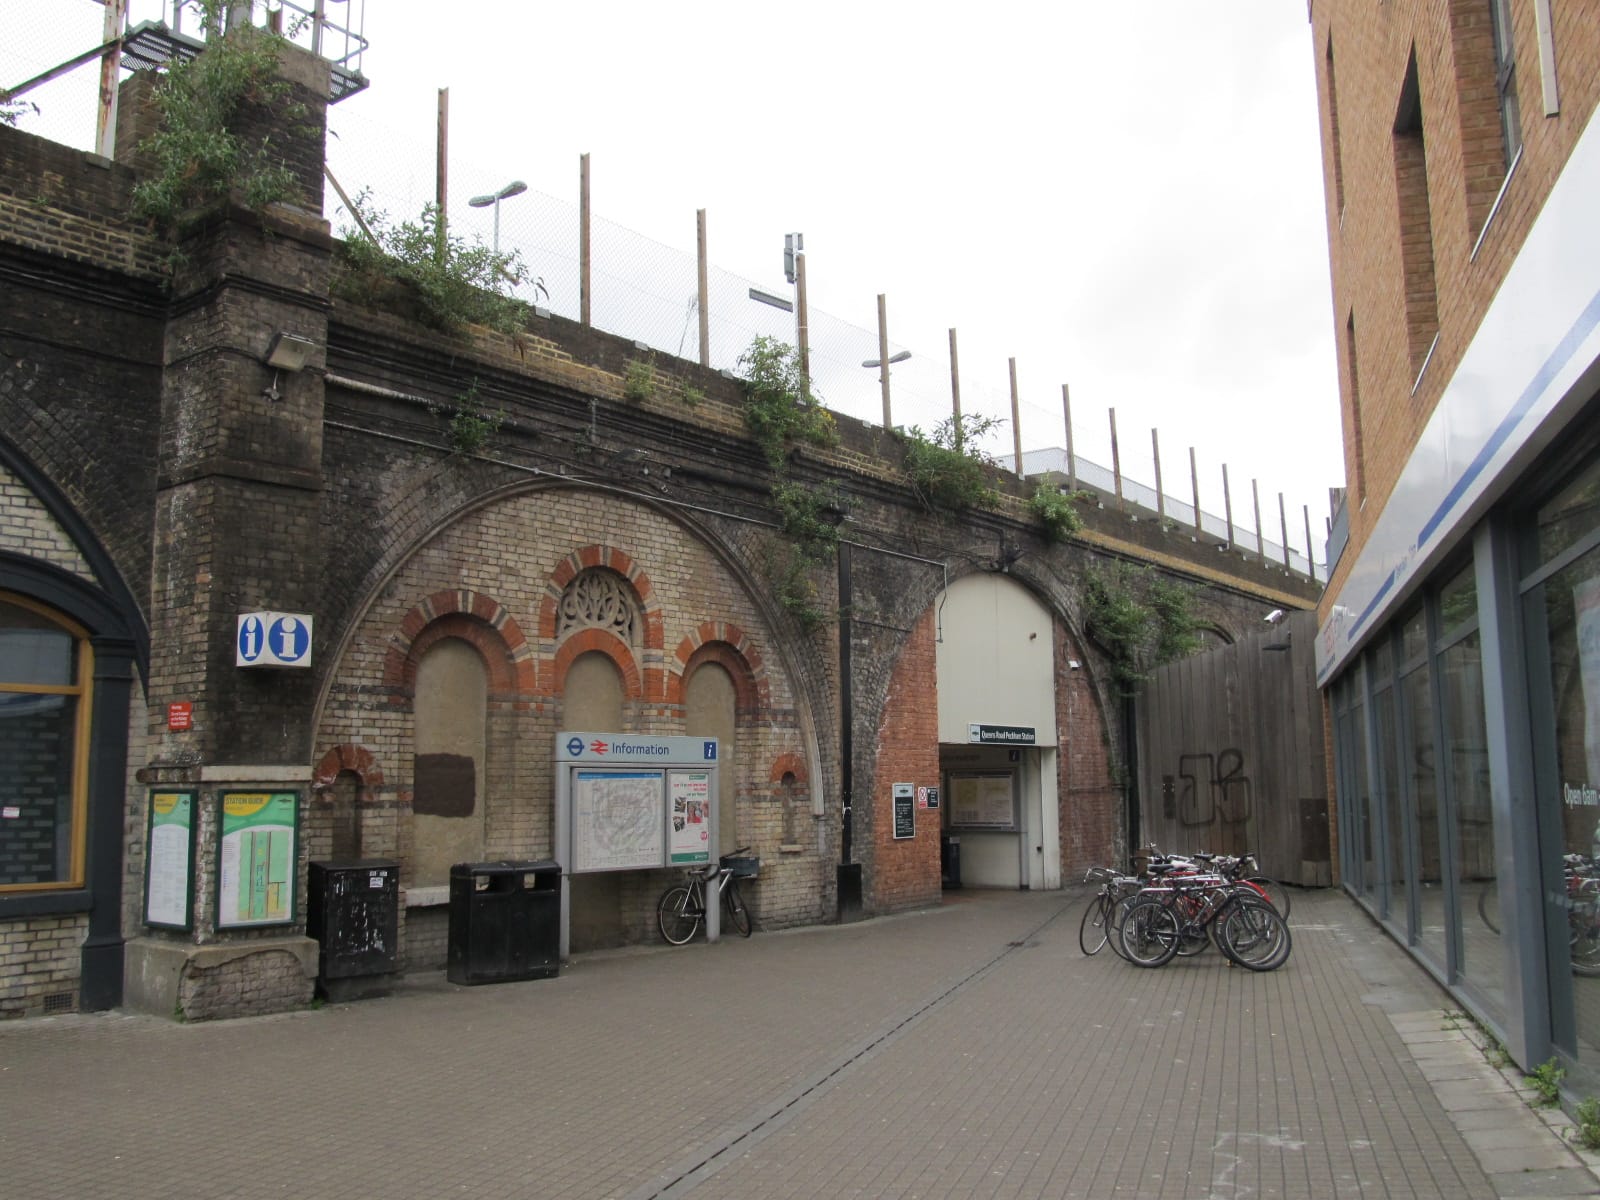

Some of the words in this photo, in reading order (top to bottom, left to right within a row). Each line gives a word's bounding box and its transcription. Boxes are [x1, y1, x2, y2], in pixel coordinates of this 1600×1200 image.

[996, 731, 1005, 739] Road
[1005, 731, 1021, 740] Peckham
[1021, 732, 1035, 740] Station
[612, 743, 670, 756] Information
[1564, 782, 1581, 810] Open
[1583, 784, 1597, 805] 6am
